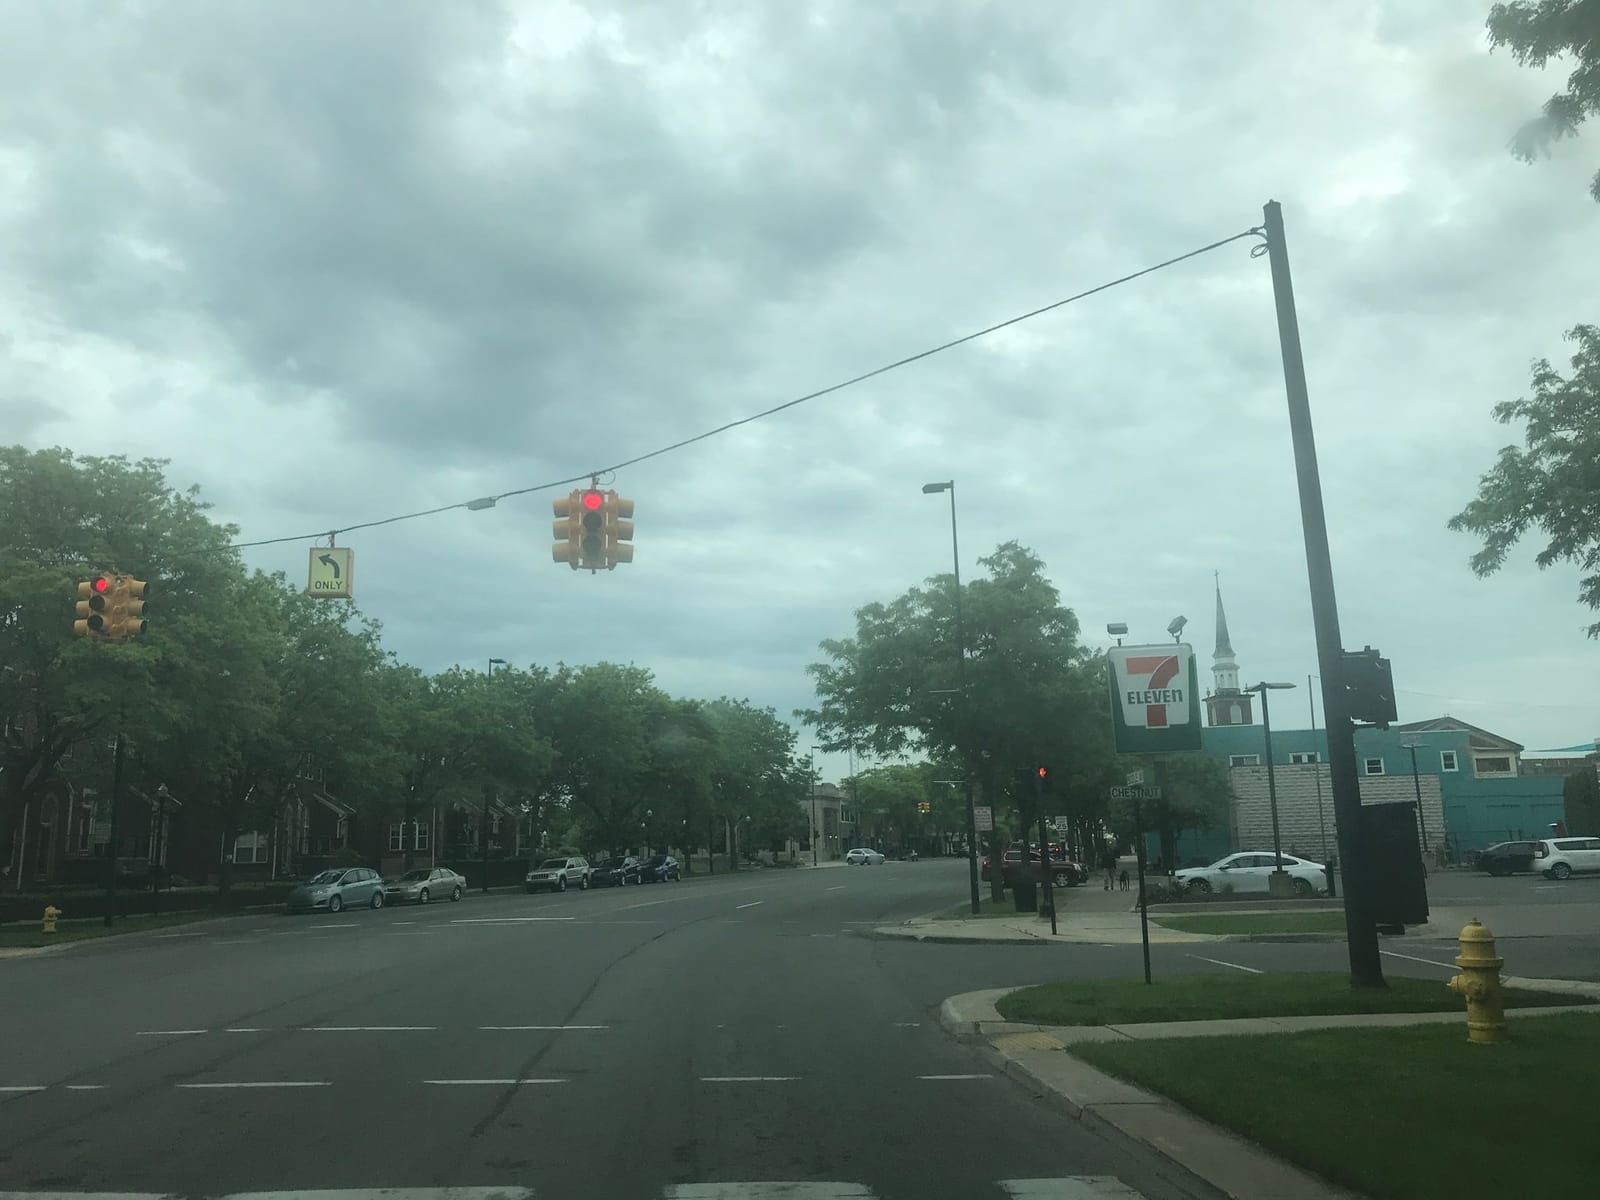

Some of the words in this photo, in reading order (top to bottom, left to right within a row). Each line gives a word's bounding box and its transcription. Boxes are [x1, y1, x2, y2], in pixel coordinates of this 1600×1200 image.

[315, 580, 342, 590] ONLY
[1126, 655, 1179, 727] 7
[1111, 787, 1159, 798] CHESTNUT
